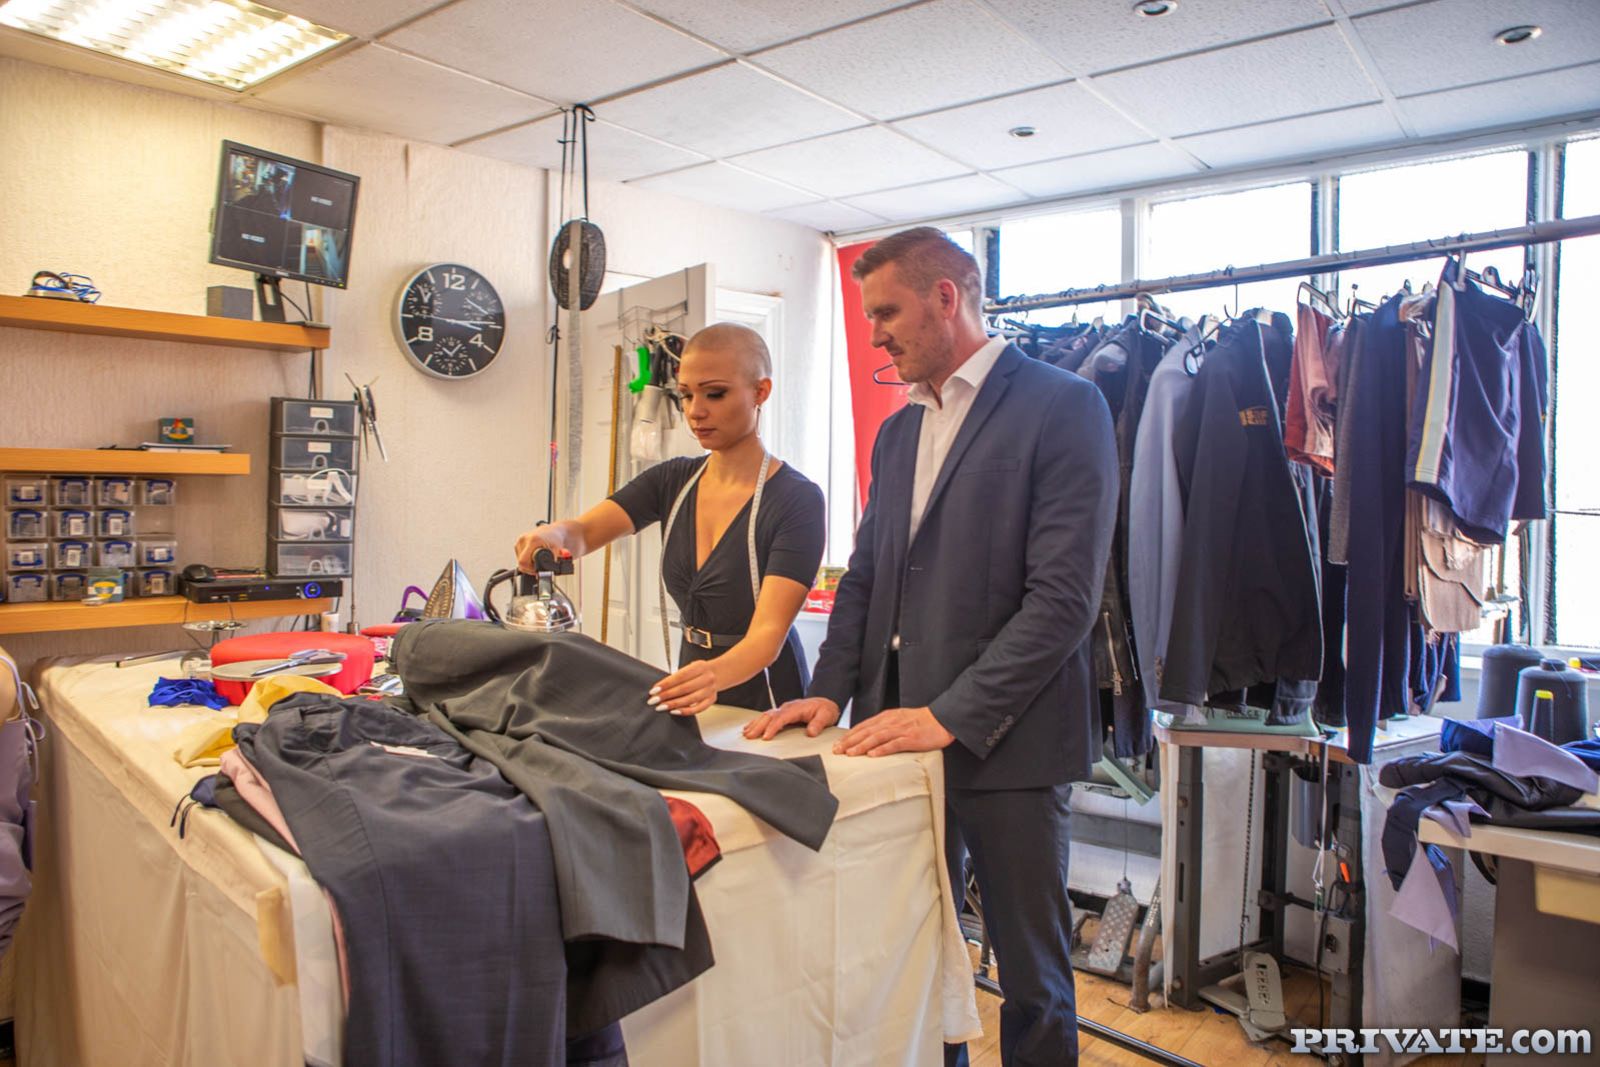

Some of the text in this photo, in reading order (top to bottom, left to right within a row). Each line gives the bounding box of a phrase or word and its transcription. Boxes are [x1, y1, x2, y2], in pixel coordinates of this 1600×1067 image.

[442, 272, 466, 291] 12
[418, 326, 434, 342] 8
[468, 333, 484, 348] 4
